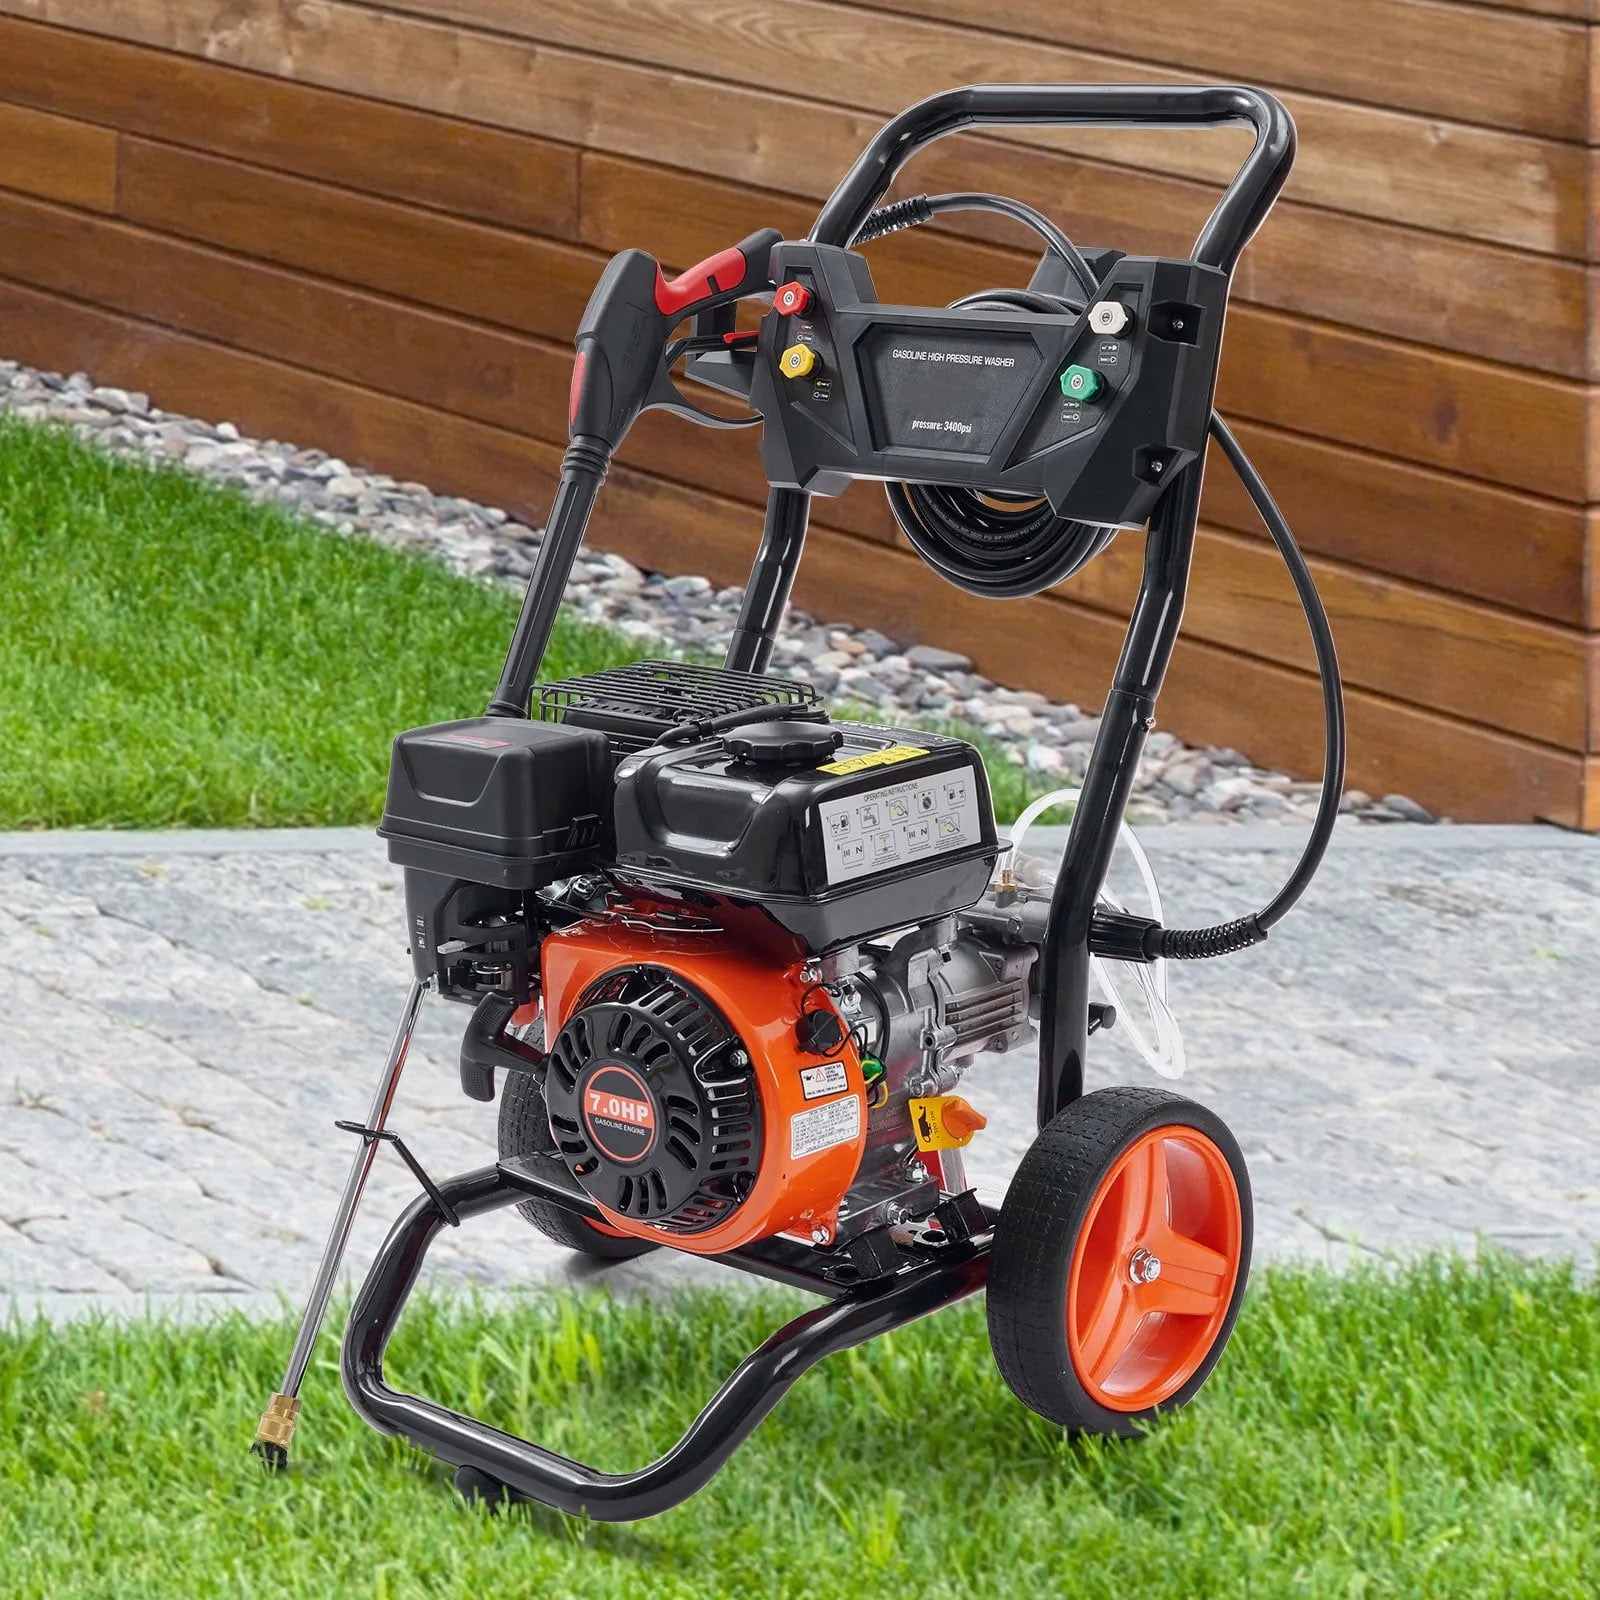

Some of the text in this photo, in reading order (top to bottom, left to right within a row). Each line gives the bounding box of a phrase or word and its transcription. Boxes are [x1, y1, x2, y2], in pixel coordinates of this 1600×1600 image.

[892, 349, 1015, 367] GASOLINE HIGH PRESSURE WASHER
[912, 420, 972, 434] pressure: 3400psi
[863, 782, 918, 802] OPERATING INSTRUCTIONS
[920, 827, 928, 836] N
[856, 845, 863, 854] N
[590, 1092, 649, 1123] 7.0HP
[929, 1111, 935, 1121] NO
[594, 1117, 646, 1136] GASOLINE ENGINE
